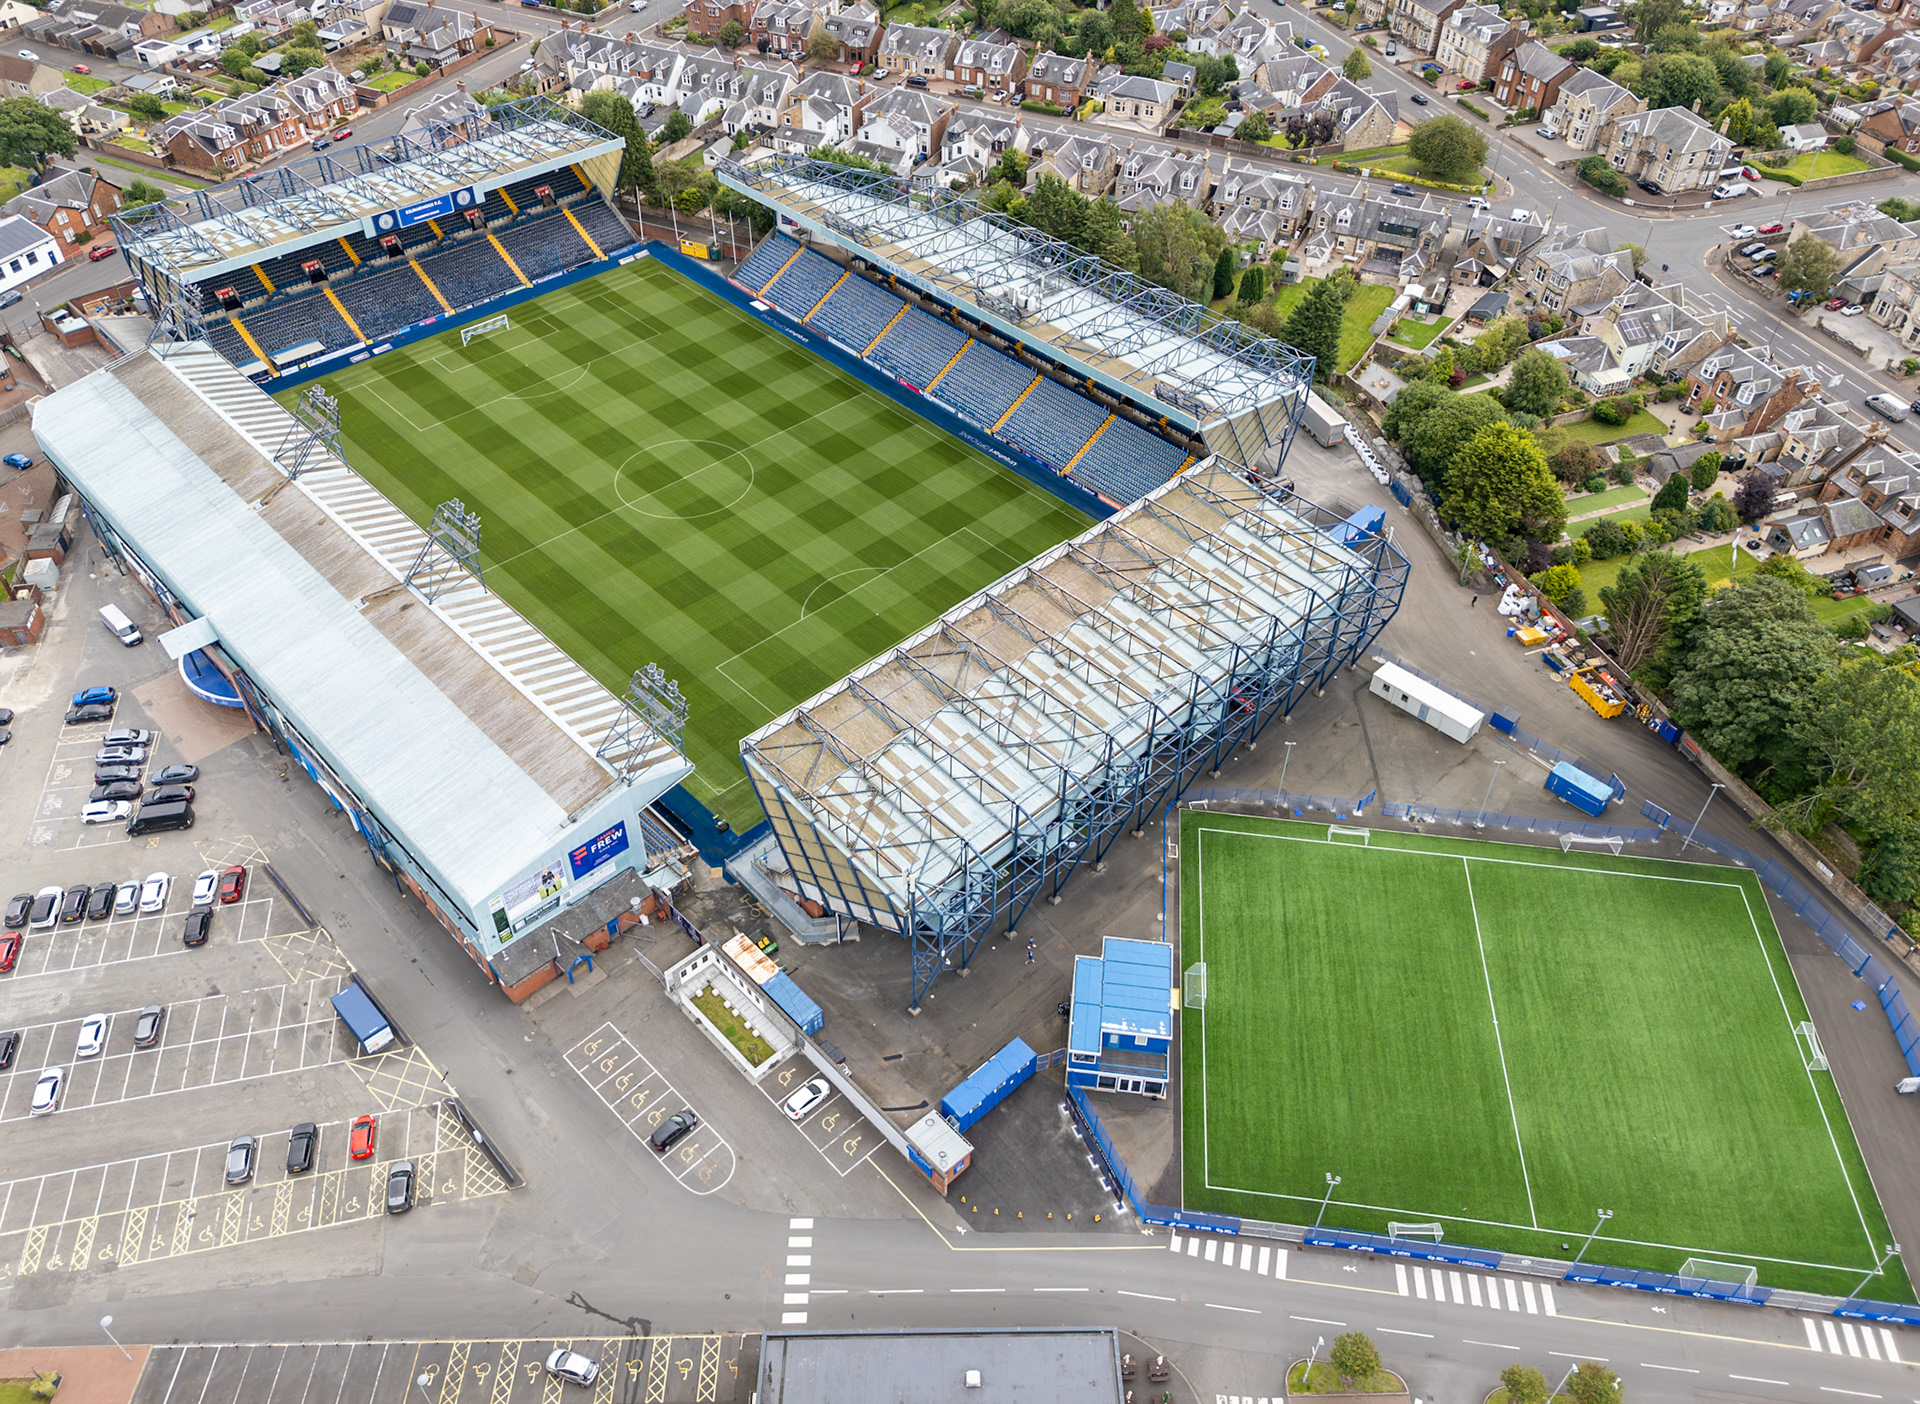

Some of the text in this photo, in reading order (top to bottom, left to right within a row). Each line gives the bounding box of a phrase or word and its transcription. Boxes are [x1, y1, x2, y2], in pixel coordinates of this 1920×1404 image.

[405, 203, 433, 214] KILMARNOCK
[876, 258, 918, 282] KILMARNOCK
[590, 828, 623, 852] FREW
[597, 829, 616, 841] JAMES
